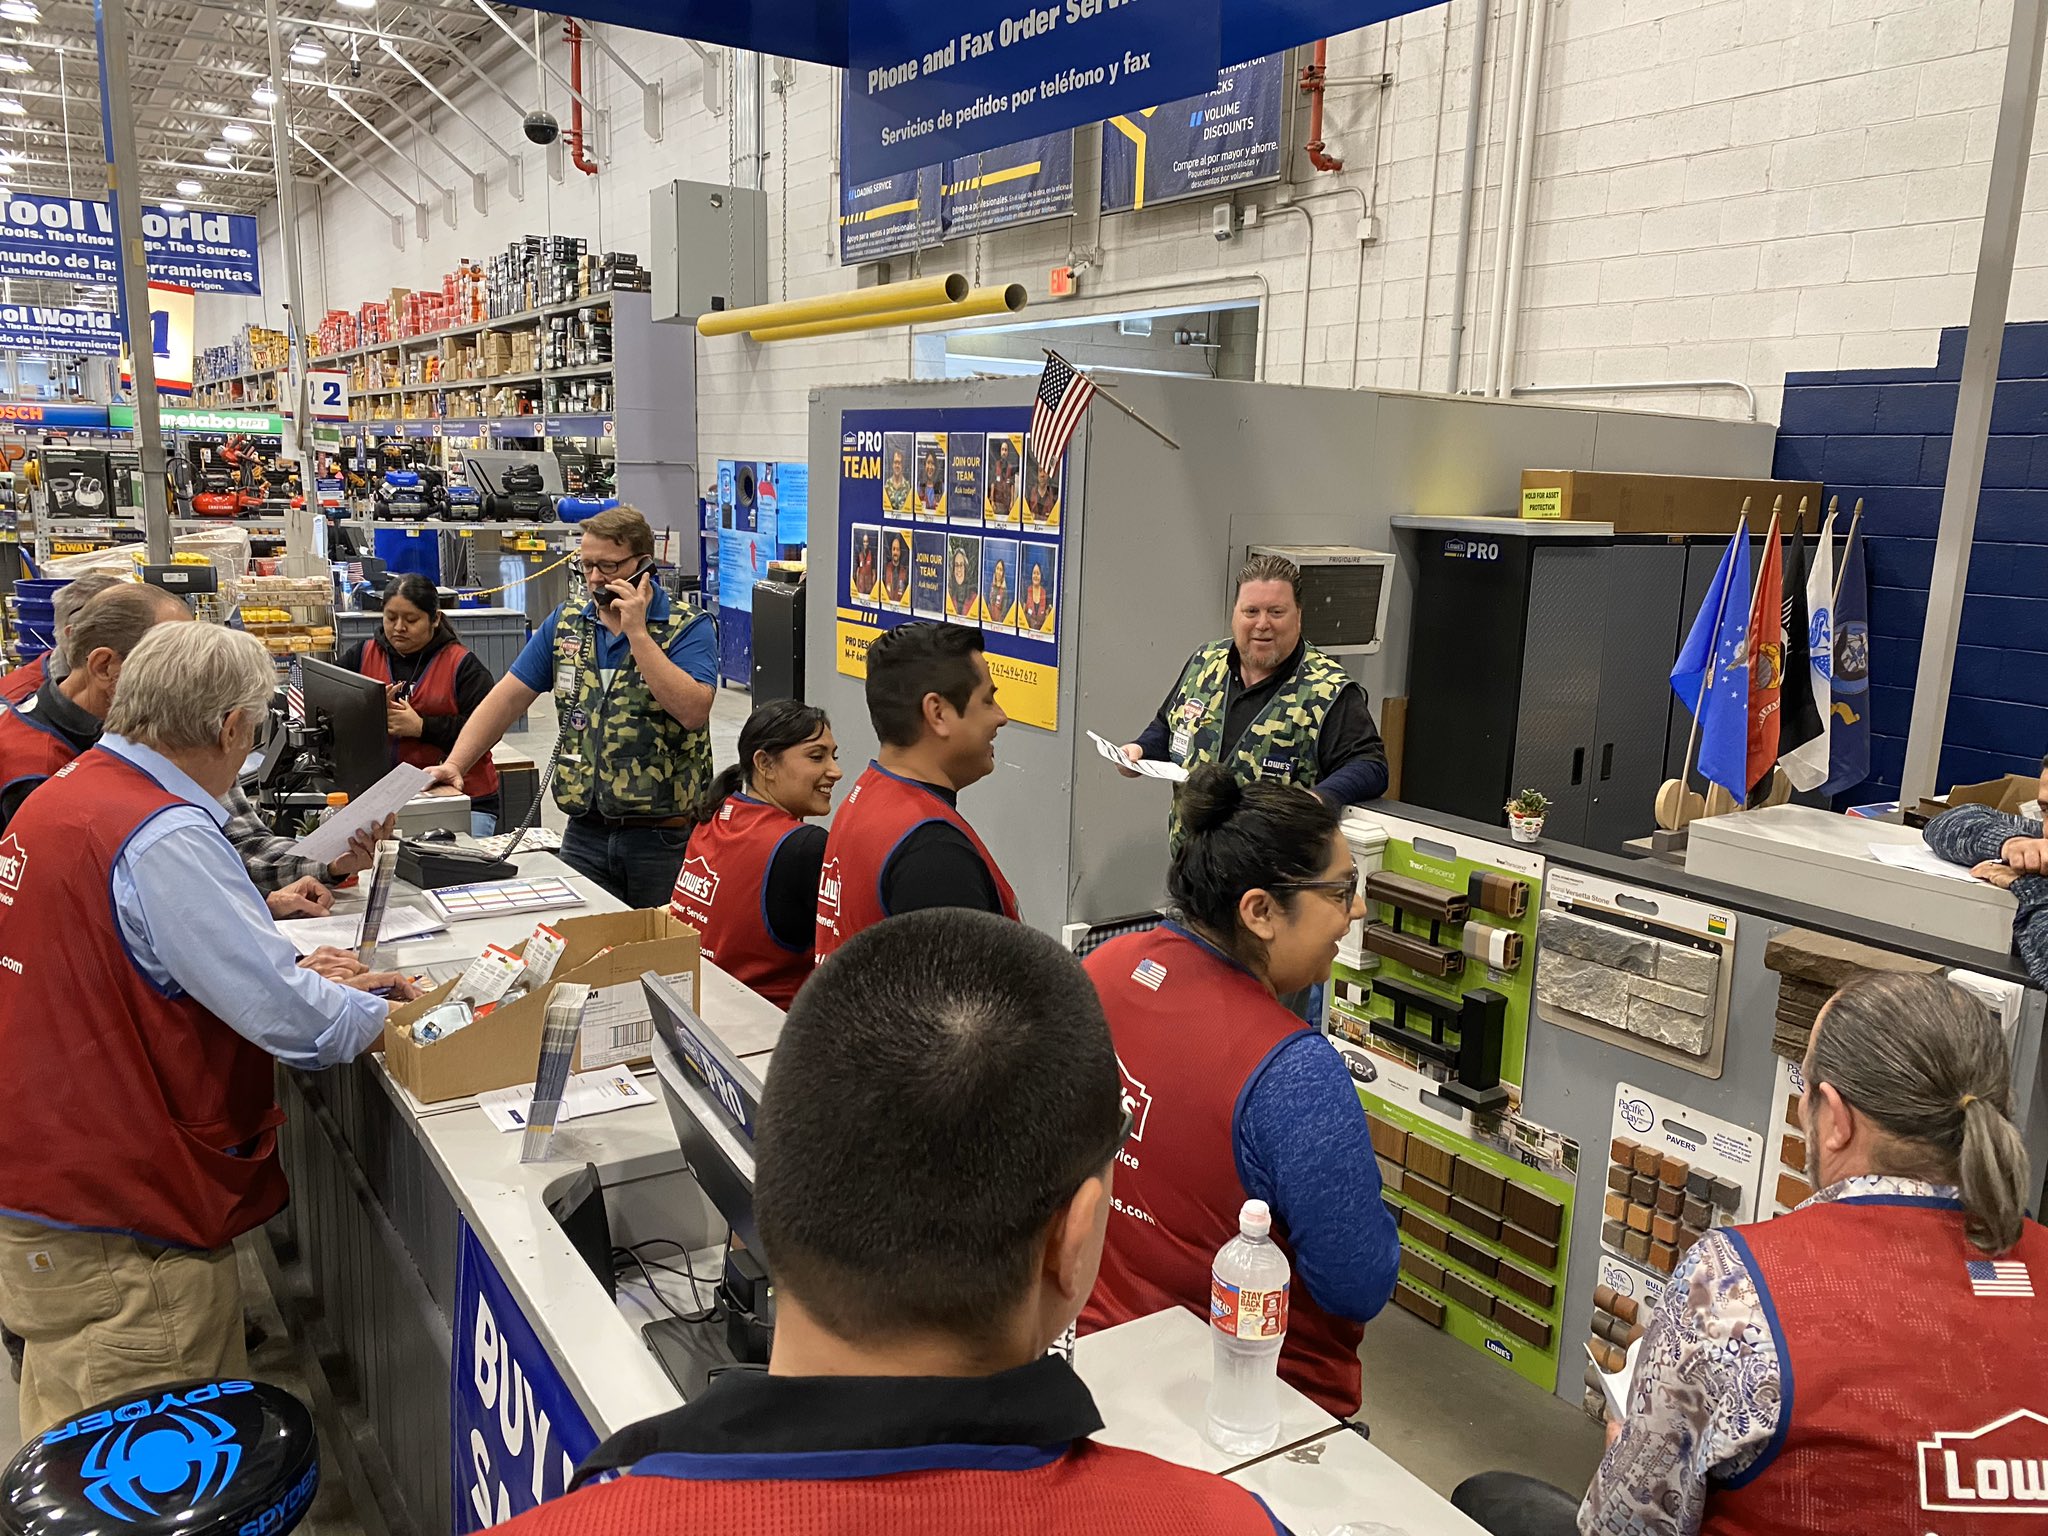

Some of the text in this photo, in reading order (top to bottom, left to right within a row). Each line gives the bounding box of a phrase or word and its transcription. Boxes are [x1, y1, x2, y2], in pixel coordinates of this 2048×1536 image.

[867, 8, 1061, 95] Phone and Fax Order
[881, 50, 1152, 146] Servicios de pedidos por teléfono y fax
[1204, 101, 1240, 121] VOLUME
[1203, 117, 1254, 140] DISCOUNTS
[1173, 141, 1278, 172] Compre al por mayor y ahorre.
[1187, 158, 1260, 179] Paquetes para contratistas y
[1191, 170, 1254, 189] descuentos por volumen.
[853, 180, 892, 199] LOADING SERVICE
[46, 230, 74, 242] The
[168, 241, 194, 253] The
[197, 244, 251, 258] Source.
[65, 254, 89, 269] de
[1, 265, 20, 275] Las
[22, 267, 94, 281] herramientas.
[96, 273, 106, 281] El
[190, 282, 224, 290] origen.
[32, 308, 111, 329] World
[16, 335, 30, 344] de
[323, 382, 341, 405] 2
[160, 413, 266, 429] metabo HPT
[857, 431, 882, 452] PRO
[843, 456, 881, 480] TEAM
[952, 456, 980, 467] JOIN OUR
[956, 471, 975, 481] TEAM.
[1546, 491, 1559, 499] ASSET
[1529, 503, 1555, 511] PROTECTION
[115, 532, 145, 540] KOBAL
[54, 543, 94, 553] DEWALT
[1467, 542, 1498, 560] PRO
[915, 553, 943, 565] JOIN OUR
[920, 566, 938, 578] TEAM.
[845, 635, 871, 651] PRO DES
[845, 649, 855, 660] M-F
[1262, 758, 1291, 771] LOWE'S
[1409, 860, 1456, 879] Trex Transcend
[1565, 886, 1591, 900] Versetta
[1591, 894, 1609, 905] Stone
[686, 905, 708, 924] Service
[1343, 1051, 1373, 1080] Trex
[700, 1052, 746, 1126] PRO
[1619, 1098, 1645, 1116] Pacific
[1621, 1109, 1639, 1125] Clay
[1666, 1134, 1697, 1152] PAVERS
[1604, 1266, 1626, 1284] Pacific
[1240, 1290, 1262, 1300] STAY
[1240, 1299, 1261, 1308] BACK
[1486, 1340, 1510, 1360] LOWE'S
[474, 1290, 551, 1506] BUY
[42, 1381, 254, 1446] SPYDER
[239, 1460, 319, 1536] SPYDER
